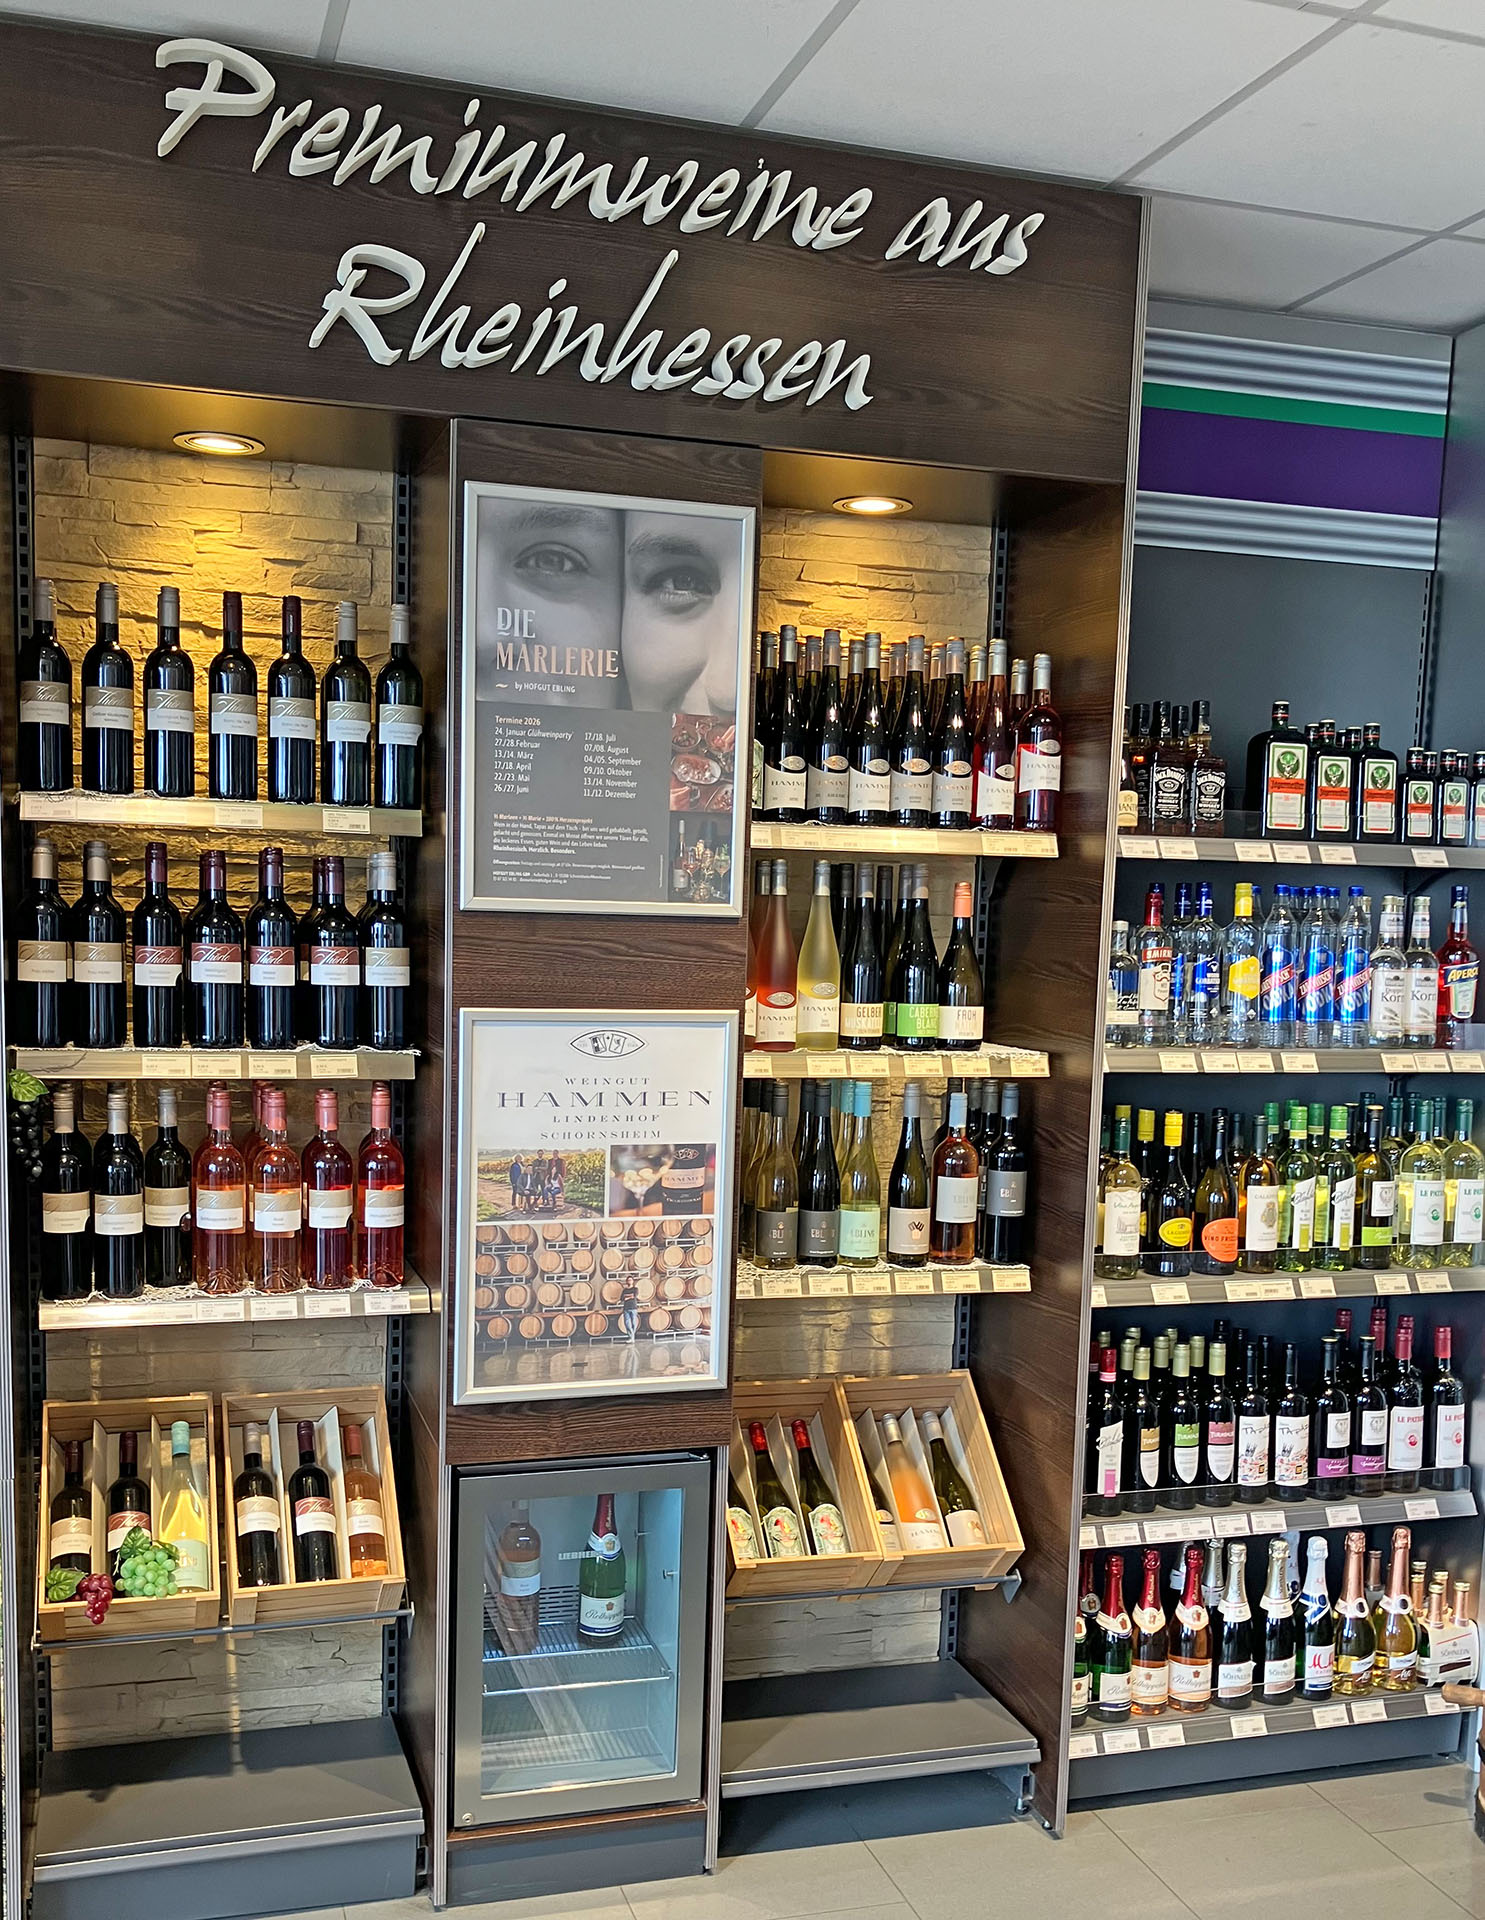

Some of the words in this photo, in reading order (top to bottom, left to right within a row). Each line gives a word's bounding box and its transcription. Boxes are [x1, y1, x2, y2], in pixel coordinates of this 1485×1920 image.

[155, 37, 874, 251] Premiumweine
[886, 196, 1046, 275] aus
[309, 221, 874, 411] Rheinhessen
[497, 607, 536, 638] DIE
[496, 641, 619, 678] MARLERIE
[514, 682, 523, 691] by
[524, 683, 551, 692] HOFGUT
[552, 684, 576, 693] EBLING
[495, 715, 523, 725] Termine
[524, 717, 541, 726] 2026
[495, 727, 504, 735] 24.
[506, 727, 526, 737] Januar
[606, 733, 617, 743] Juli
[517, 751, 534, 759] März
[607, 745, 629, 755] August
[516, 762, 532, 771] April
[608, 756, 641, 767] September
[607, 767, 632, 776] Oktober
[517, 774, 530, 782] Mai
[605, 779, 637, 788] November
[516, 785, 529, 794] Juni
[605, 790, 637, 799] Dezember
[565, 1077, 650, 1085] WEINGUT
[496, 1090, 713, 1108] HAMMEN
[553, 1114, 661, 1123] LINDENHOF
[540, 1130, 661, 1139] SCHORNSHEIM
